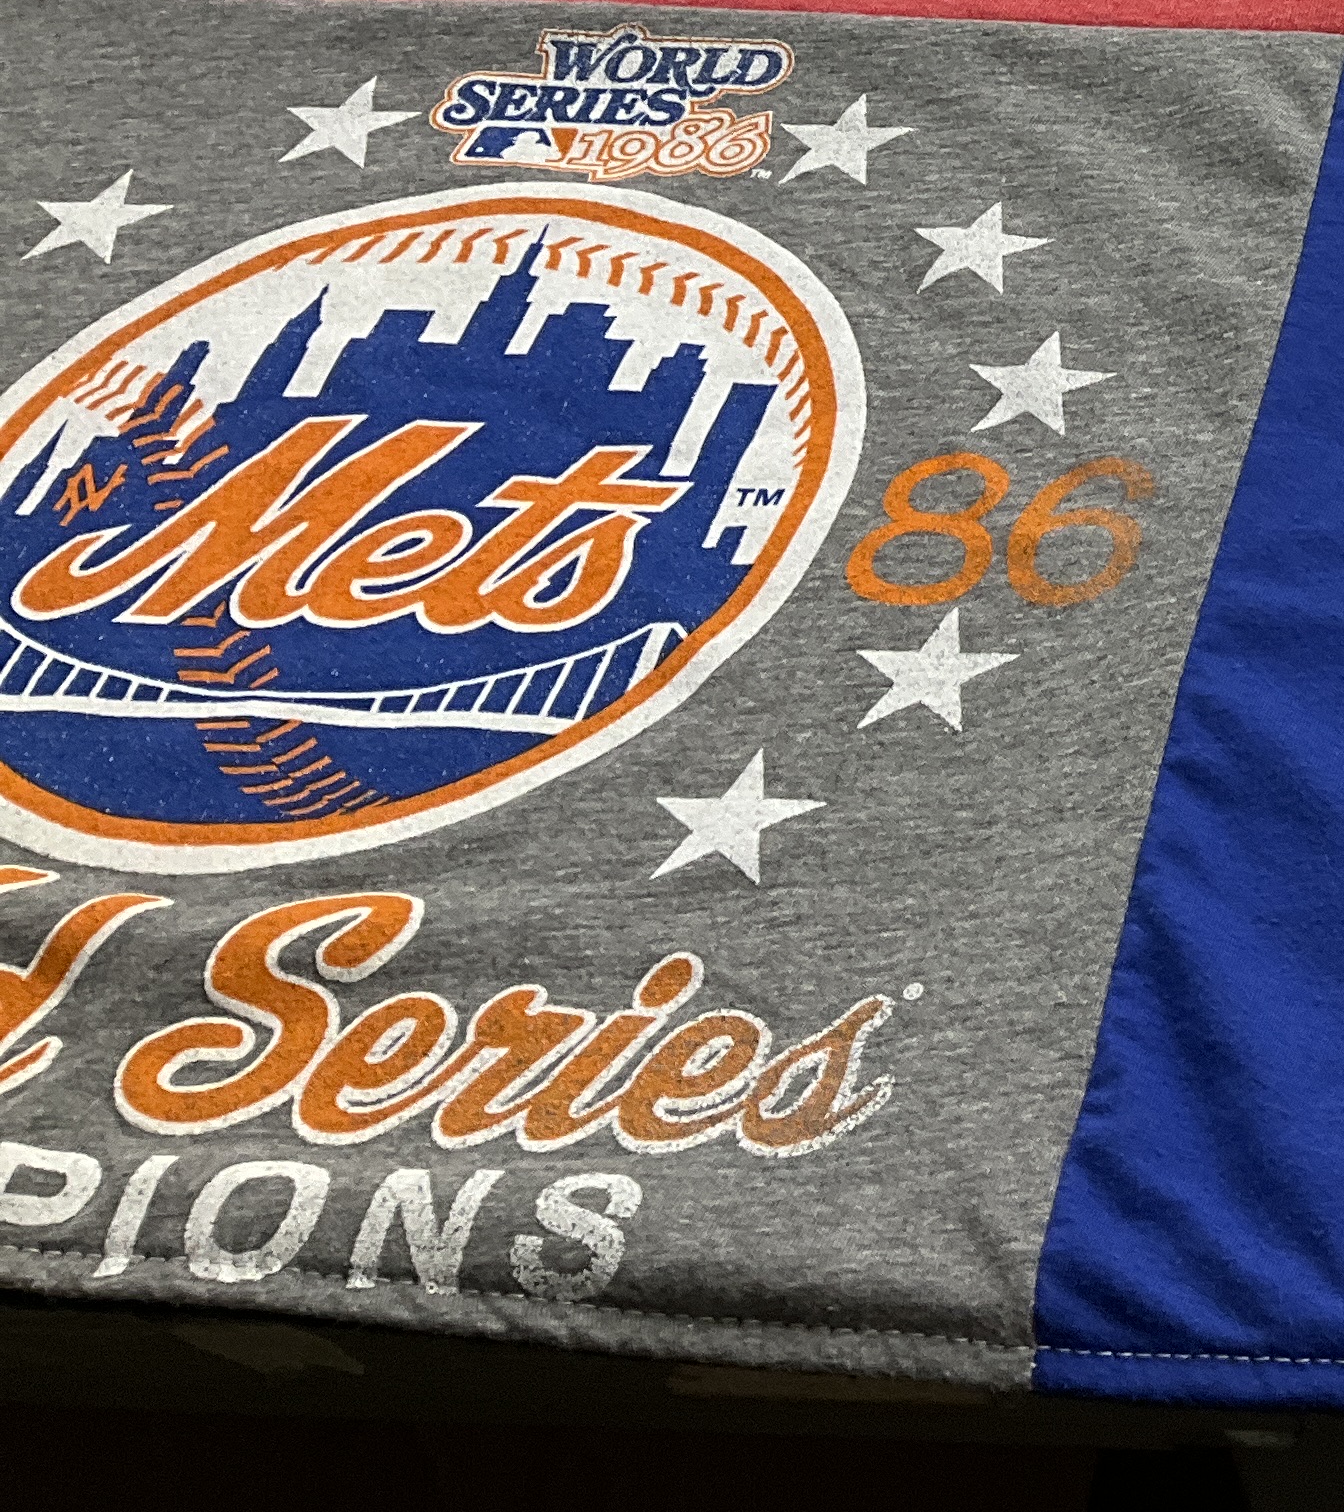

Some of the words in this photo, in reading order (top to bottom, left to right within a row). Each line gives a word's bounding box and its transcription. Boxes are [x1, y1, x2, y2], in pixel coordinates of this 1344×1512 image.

[442, 78, 689, 128] SERIES
[549, 33, 786, 98] WORLD
[565, 110, 773, 180] 1986
[12, 413, 697, 636] Mets
[844, 451, 1154, 609] 86
[114, 890, 897, 1159] Series
